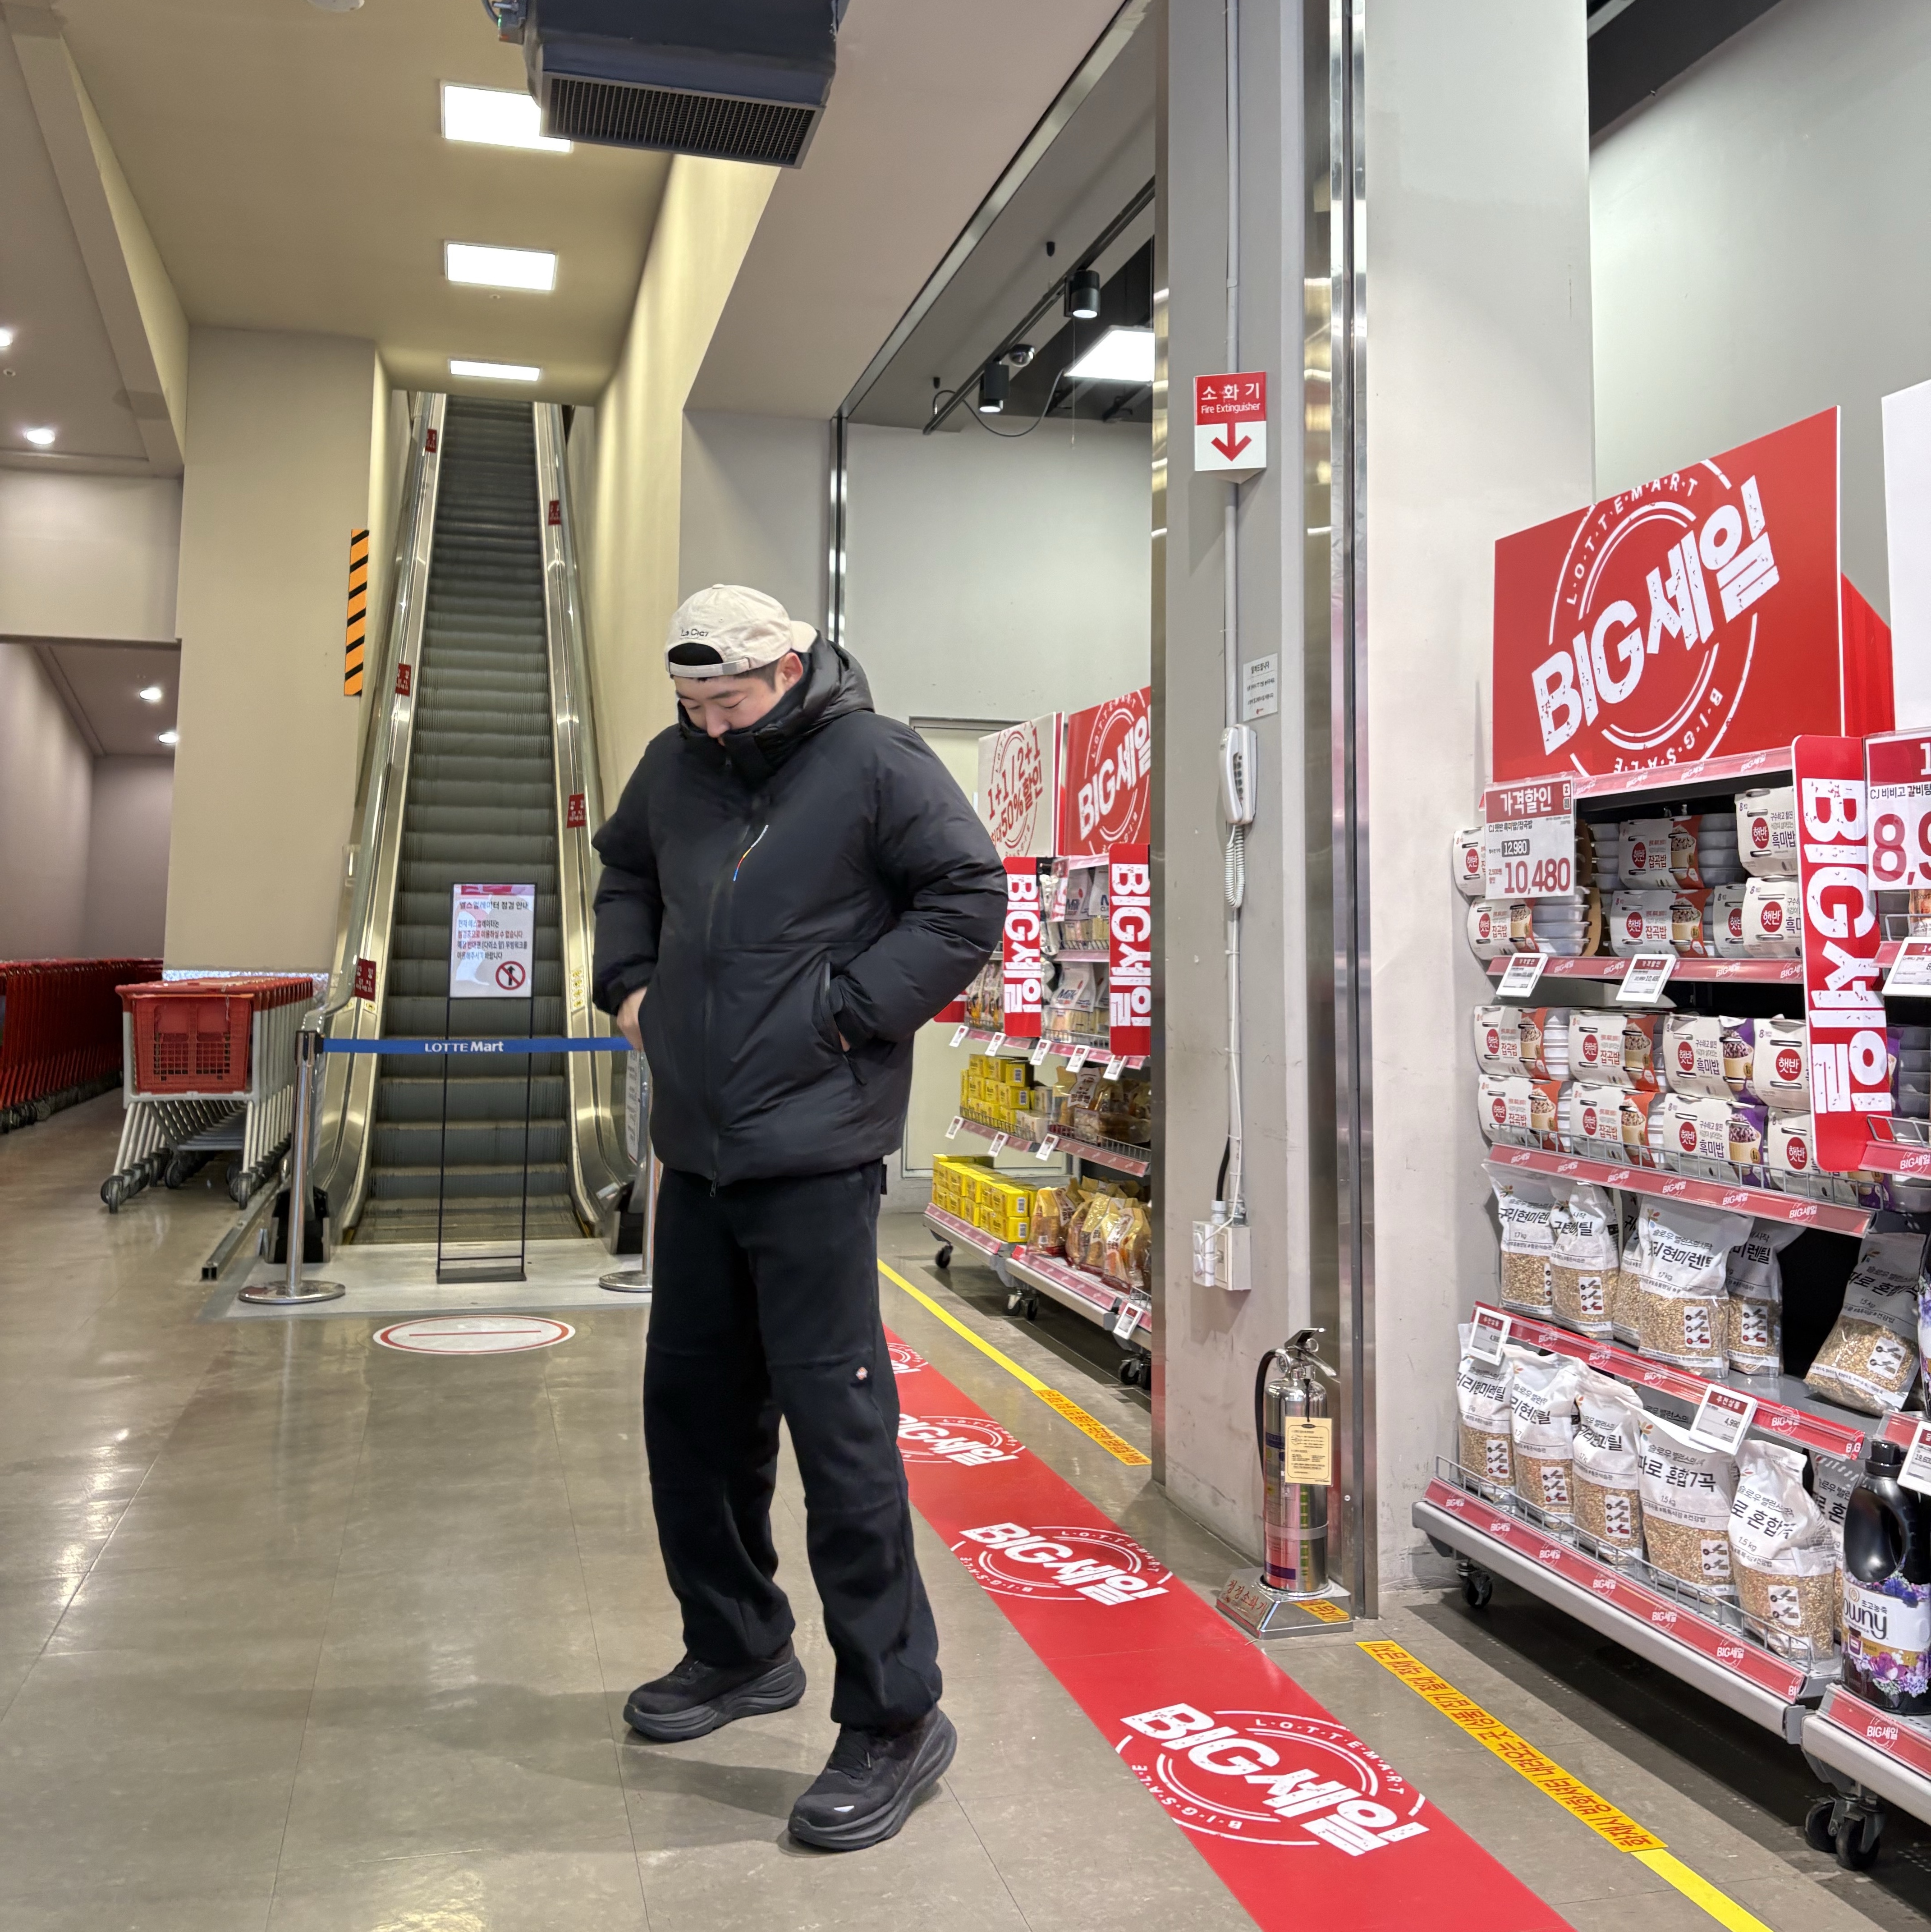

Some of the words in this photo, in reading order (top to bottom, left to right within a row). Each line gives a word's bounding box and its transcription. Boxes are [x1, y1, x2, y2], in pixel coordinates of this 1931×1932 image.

[1201, 405, 1215, 414] Fire
[1216, 402, 1261, 413] Extinguisher
[1532, 475, 1780, 756] BIG세일
[1078, 703, 1151, 840] BIG세일
[1500, 785, 1551, 816] 가격할인
[1870, 789, 1880, 799] CJ
[1881, 787, 1906, 798] 비비고
[1752, 826, 1768, 842] 햇반
[1772, 831, 1795, 849] 흑미밥
[1504, 840, 1527, 855] 12,980
[1504, 857, 1570, 895] 10,480
[502, 901, 514, 910] 점검
[516, 901, 528, 910] 안내
[1763, 907, 1781, 926] 햇반
[505, 931, 523, 939] 없습니다
[1645, 926, 1667, 940] 잡곡밥
[1004, 874, 1041, 1014] BIG세일
[1110, 863, 1151, 1027] BIG세일
[1801, 777, 1892, 1114] BIG세일
[425, 1043, 468, 1052] LOTTE
[470, 1041, 504, 1052] Mart
[1501, 1042, 1518, 1056] 잡곡밥
[1600, 1050, 1620, 1065] 잡곡밥
[1679, 1048, 1693, 1065] 햇반
[1697, 1057, 1720, 1075] 흑미밥
[1778, 1057, 1800, 1074] 햇반
[1599, 1124, 1618, 1140] 잡곡밥
[1680, 1128, 1695, 1146] 햇반
[1699, 1139, 1724, 1158] 흑미밥
[1788, 1145, 1806, 1163] 햇반
[1899, 1153, 1931, 1170] BIG세일
[1722, 1192, 1748, 1206] BIG세일
[1789, 1205, 1817, 1219] BIG세일
[1652, 1229, 1673, 1240] 슬로우
[1513, 1383, 1532, 1397] 슬로우
[1716, 1395, 1740, 1409] 추천상품
[1724, 1417, 1739, 1428] 4,990
[898, 1413, 1019, 1467] BIG세일
[1648, 1444, 1671, 1457] 슬로우
[1638, 1455, 1663, 1478] 파로
[1738, 1485, 1761, 1501] 슬로우
[1748, 1542, 1757, 1552] kg
[959, 1522, 1170, 1606] BIG세일
[1862, 1600, 1888, 1614] 초고농축
[1651, 1611, 1677, 1625] BIG세일
[1716, 1646, 1744, 1659] BIG세일
[1385, 1660, 1432, 1675] 적재
[1406, 1676, 1453, 1692] 절대
[1427, 1692, 1504, 1730] (상품/집기
[1476, 1730, 1517, 1740] 곳
[1867, 1726, 1899, 1740] BIG세일
[1489, 1740, 1564, 1776] 내려오는
[1120, 1703, 1430, 1857] BIG세일
[1537, 1777, 1615, 1814] 방화셔터
[1586, 1815, 1657, 1847] 화재시
